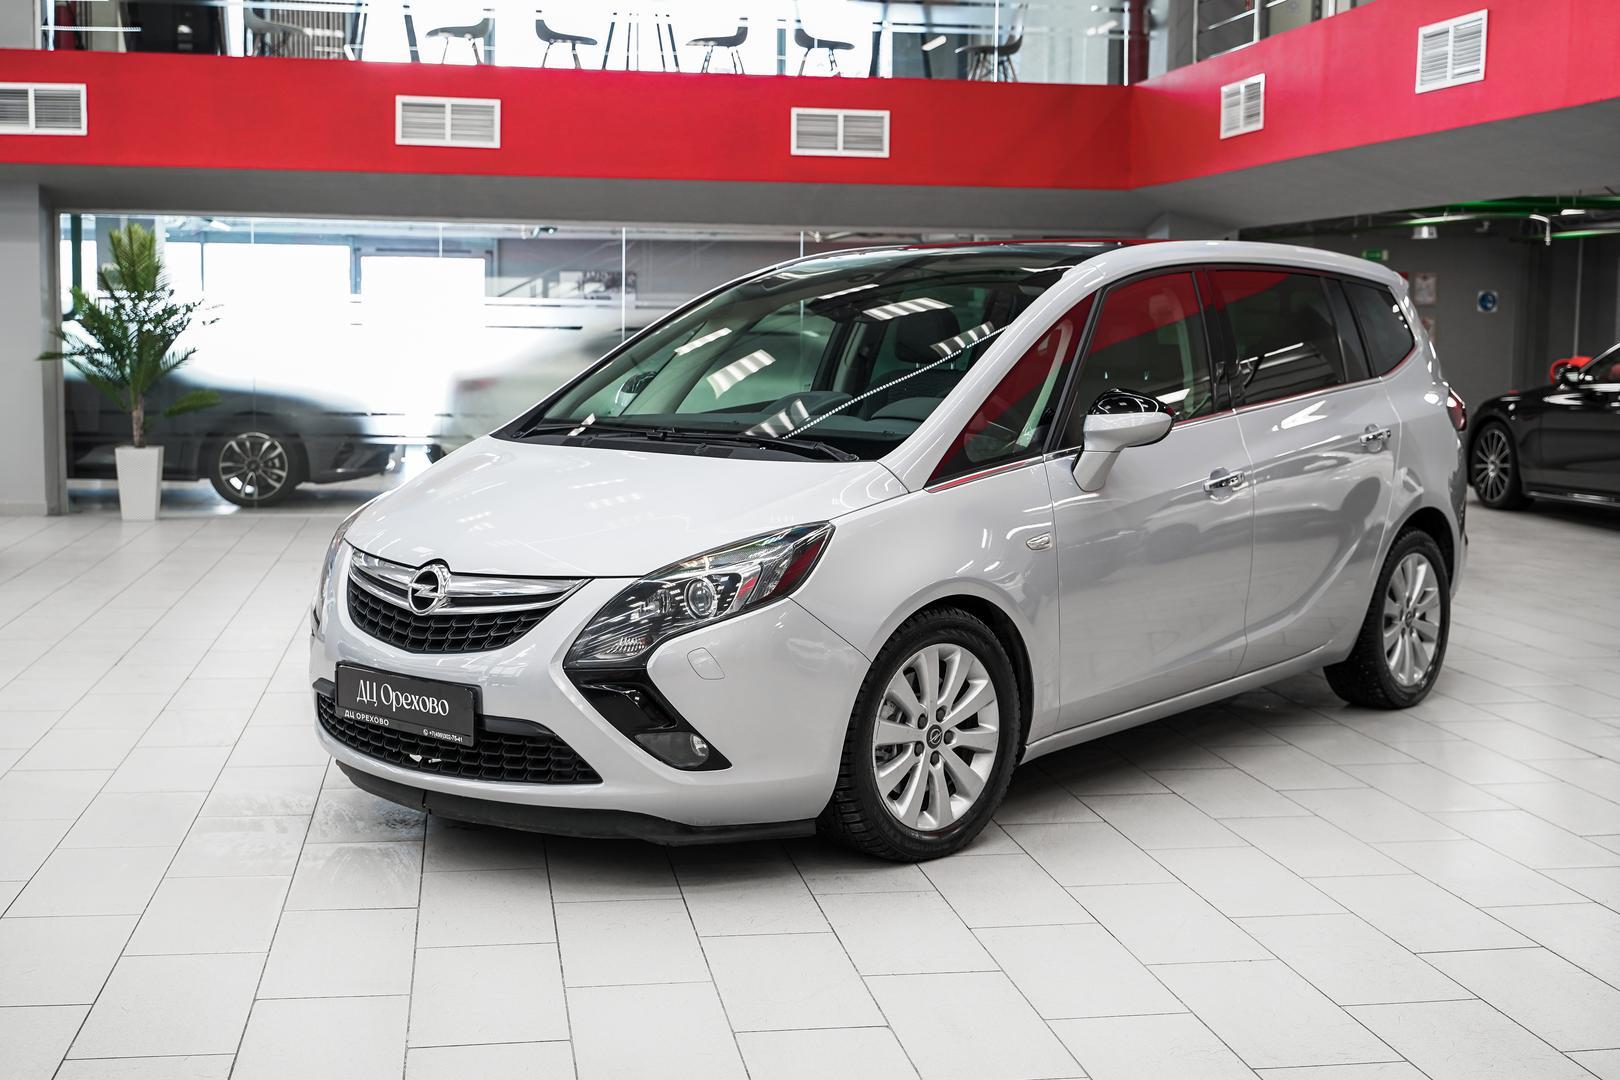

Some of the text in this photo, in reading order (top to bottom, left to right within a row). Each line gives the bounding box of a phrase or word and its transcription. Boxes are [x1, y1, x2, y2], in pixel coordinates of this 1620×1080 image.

[356, 680, 449, 716] ДЦ Орехово
[344, 709, 389, 726] ДЦ ОРЕХОВО
